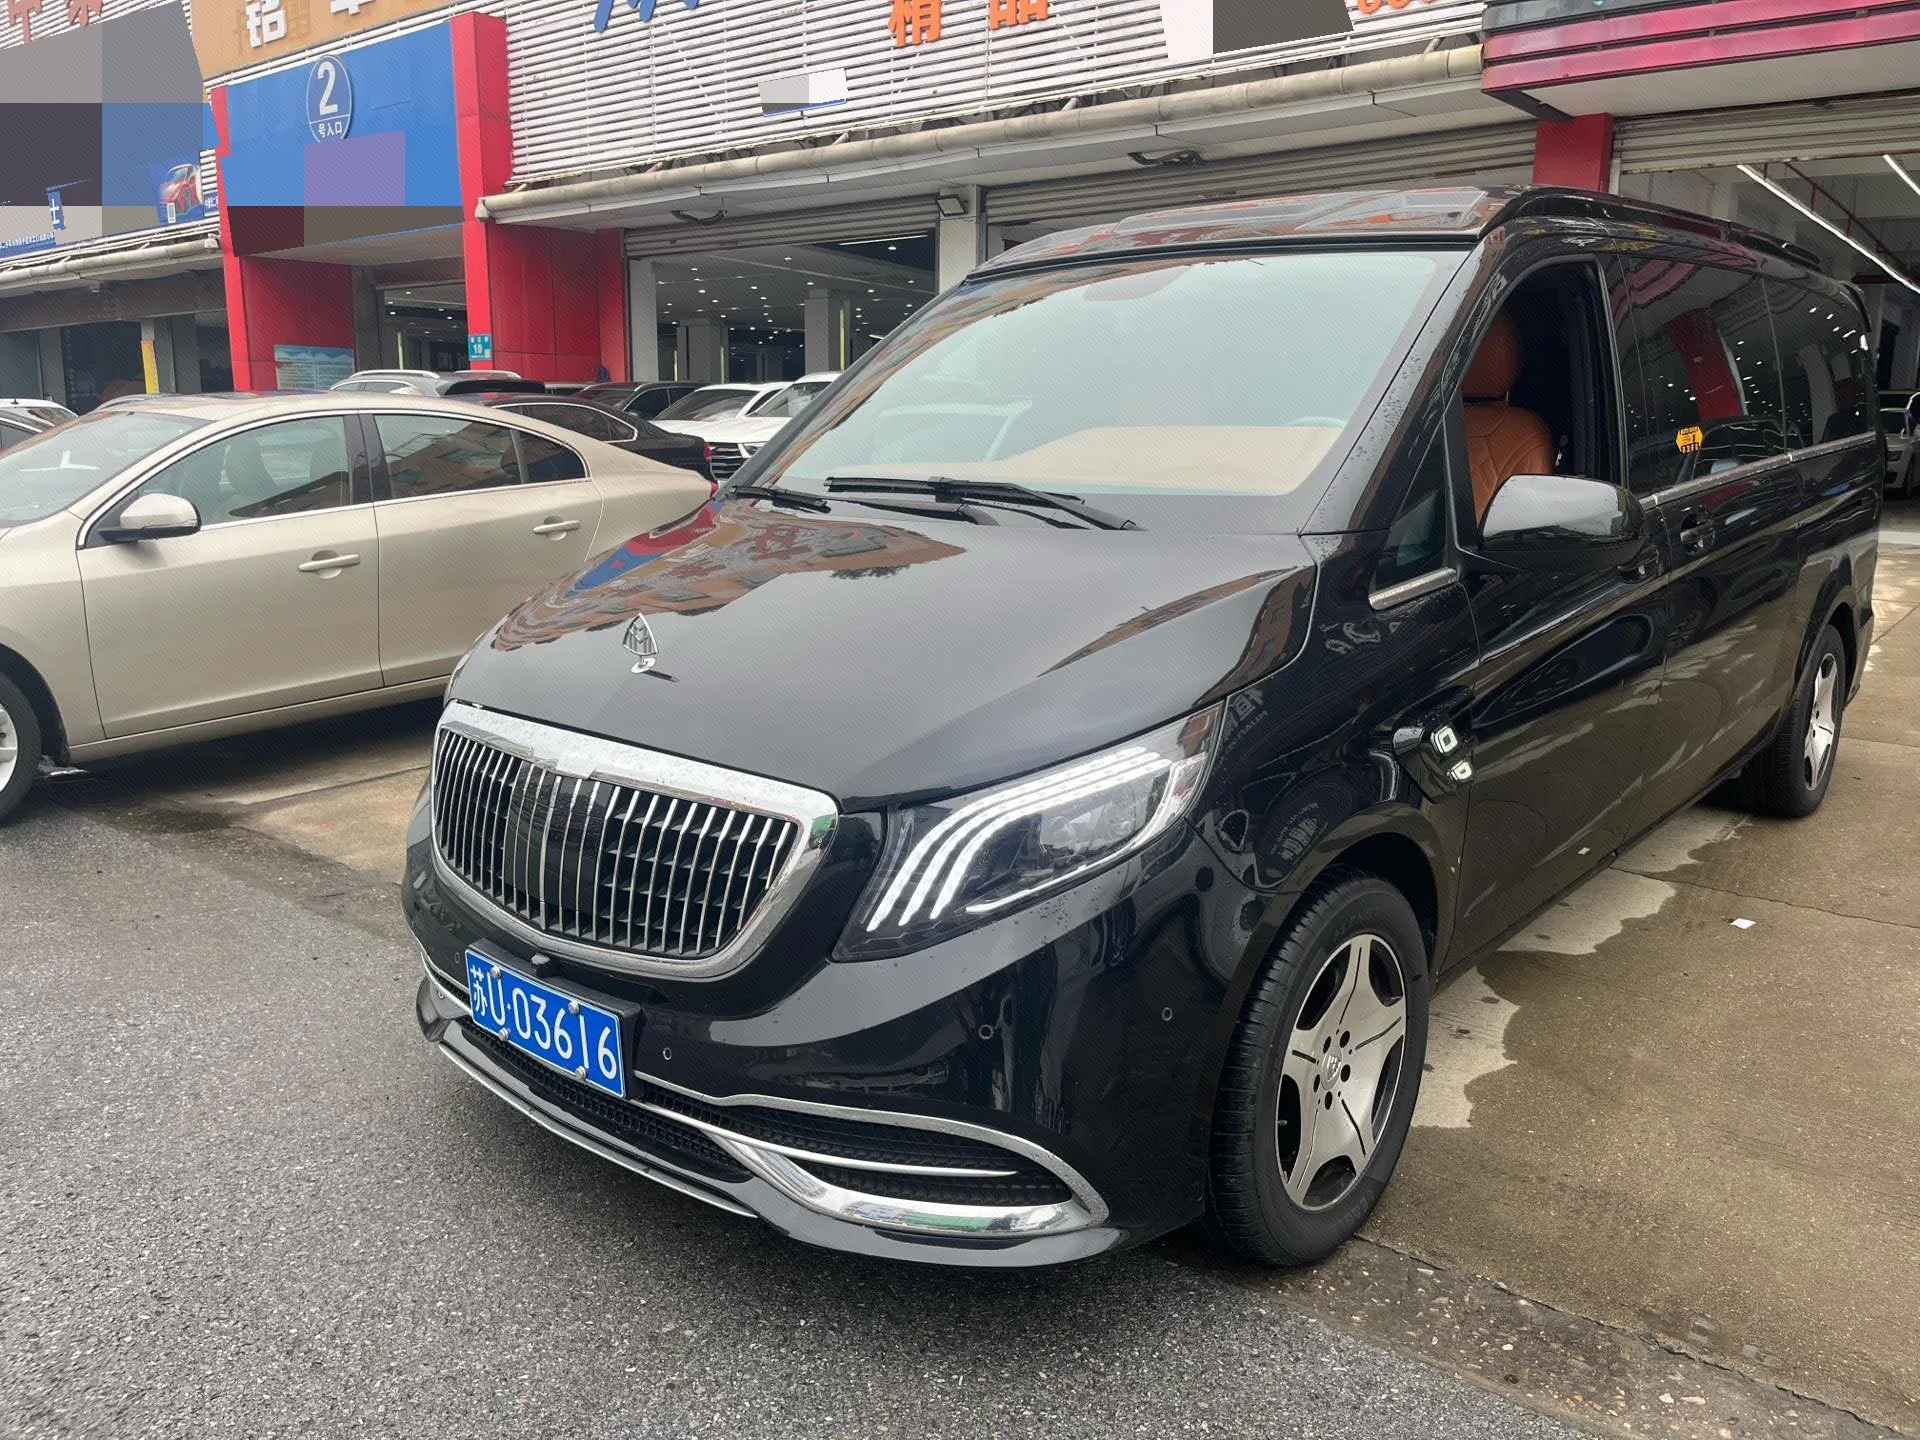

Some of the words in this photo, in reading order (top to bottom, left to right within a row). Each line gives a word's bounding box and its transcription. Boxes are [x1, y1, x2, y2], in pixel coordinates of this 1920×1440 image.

[317, 61, 338, 116] 2
[318, 121, 342, 138] 号入口
